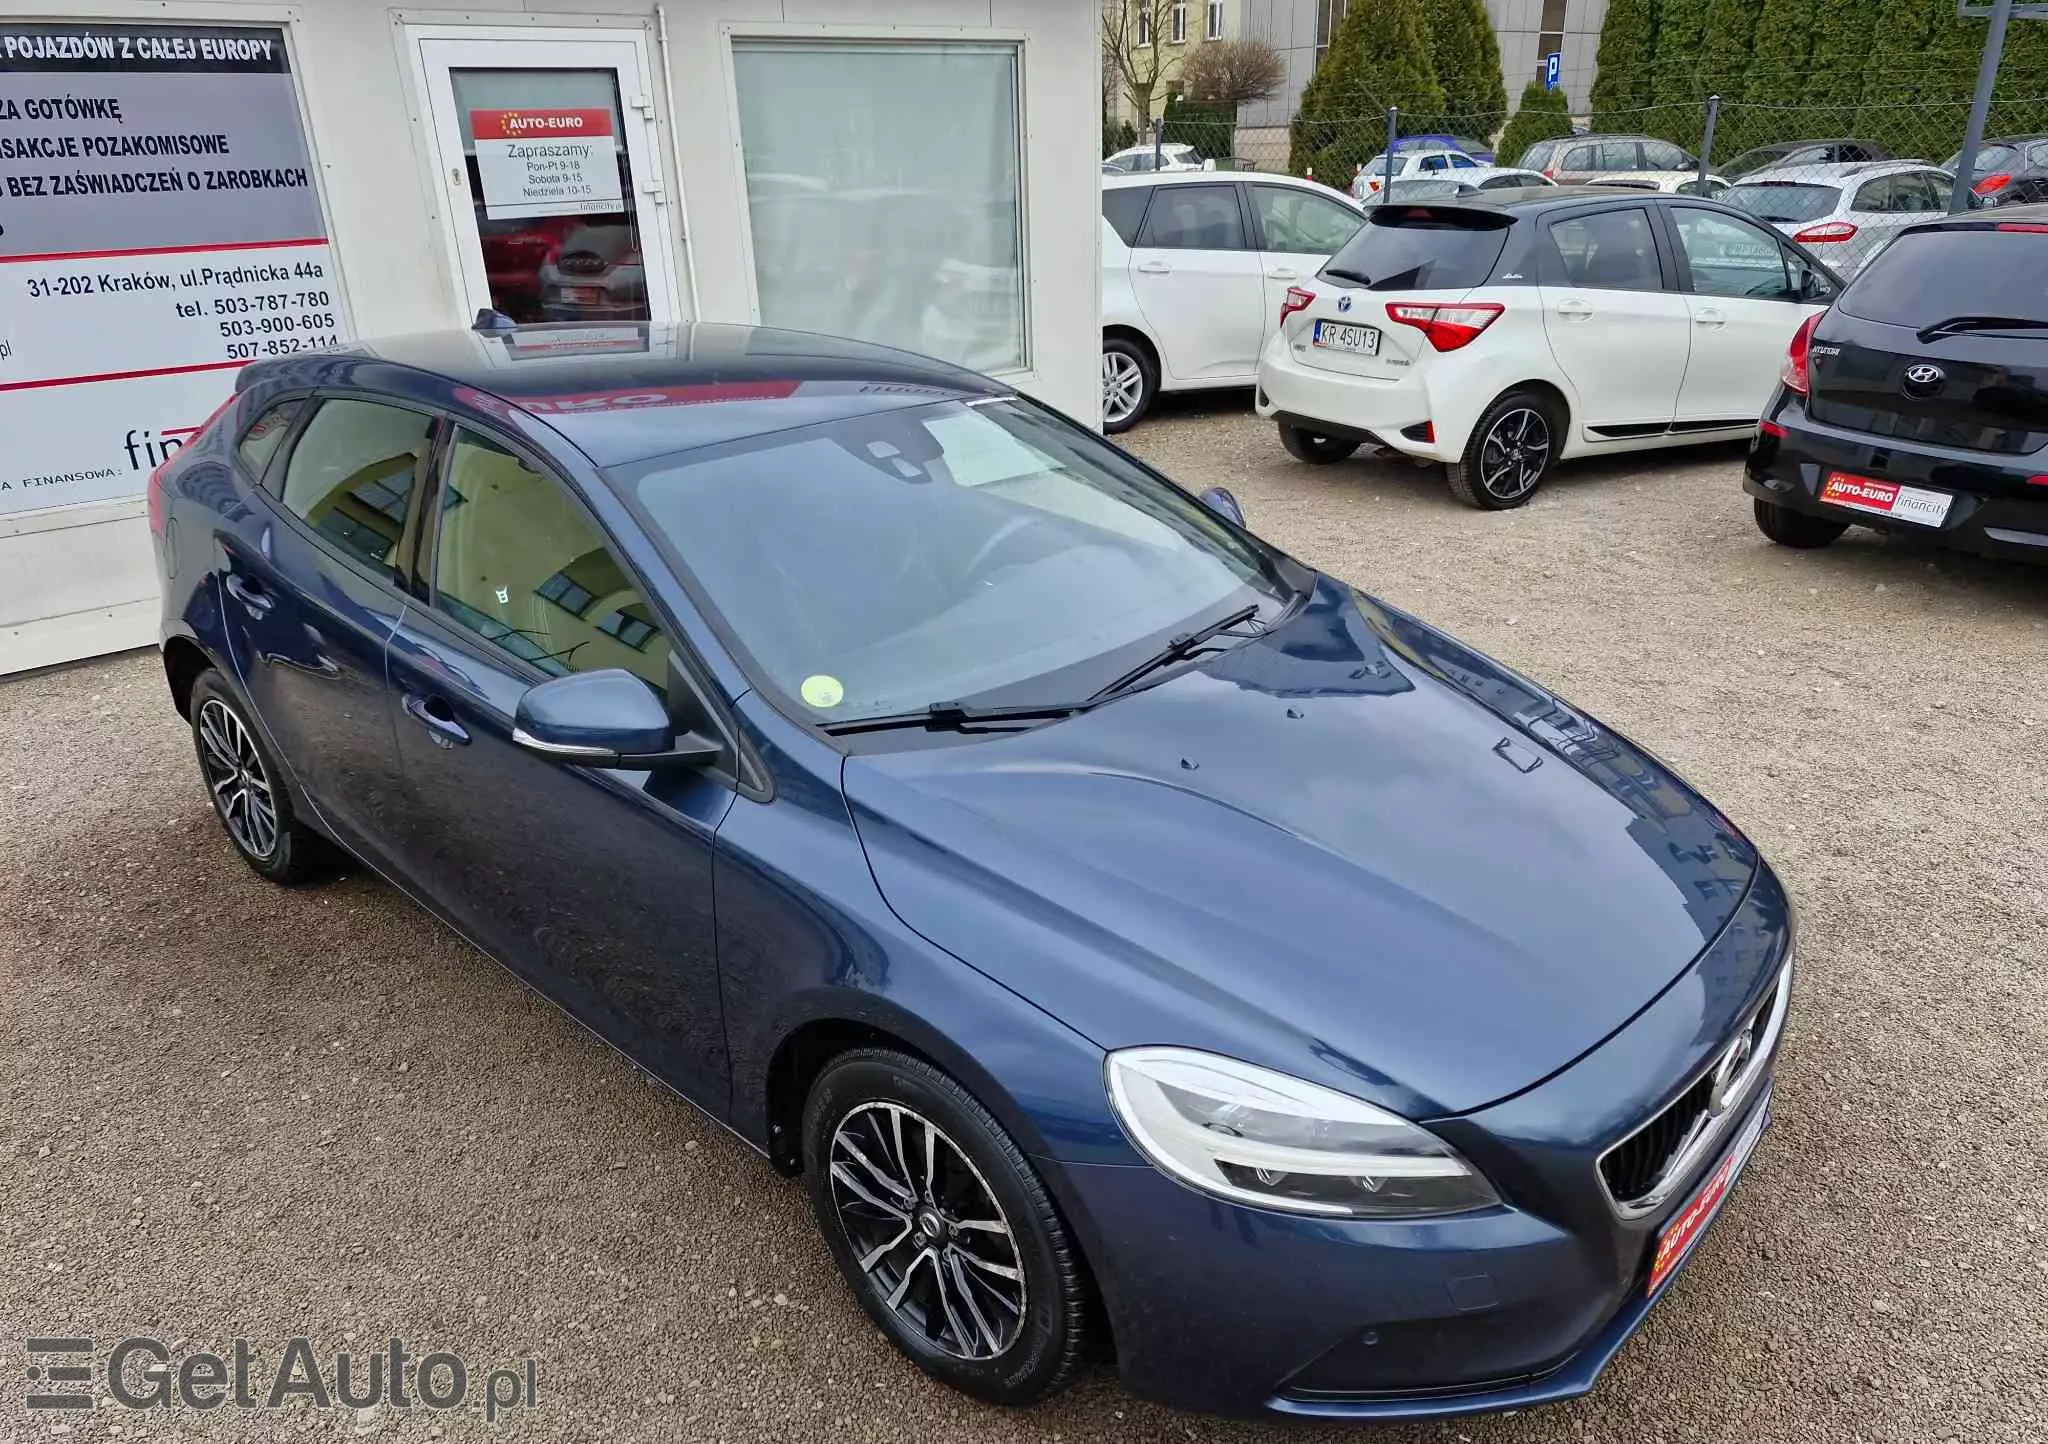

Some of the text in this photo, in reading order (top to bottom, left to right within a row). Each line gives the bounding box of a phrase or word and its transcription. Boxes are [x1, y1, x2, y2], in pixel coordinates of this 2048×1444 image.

[4, 32, 272, 61] POJAZDÓW Z CAŁEJ EUROPY
[25, 94, 122, 124] GOTÓWKĘ
[509, 116, 583, 129] AUTO-EURO
[82, 134, 230, 158] POZAKOMISOWE
[560, 160, 581, 170] 9-18
[7, 175, 48, 197] BEZ
[50, 168, 182, 196] ZAŚWIADCZEŃ
[187, 171, 201, 190] O
[203, 167, 309, 190] ZAROBKACH
[522, 184, 592, 198] Niedziela 10-15
[528, 173, 583, 185] Sobota 9-15
[27, 262, 324, 297] 31-202 Kraków, ul.Prądnicka 44a
[175, 291, 330, 319] tel. 503-787-780
[220, 312, 335, 337] 503-900-605
[1321, 323, 1376, 349] KR 4SU13
[227, 334, 338, 360] 507-852-114
[22, 467, 123, 488] FINANSOWA:
[1831, 481, 1894, 502] AUTO-EURO
